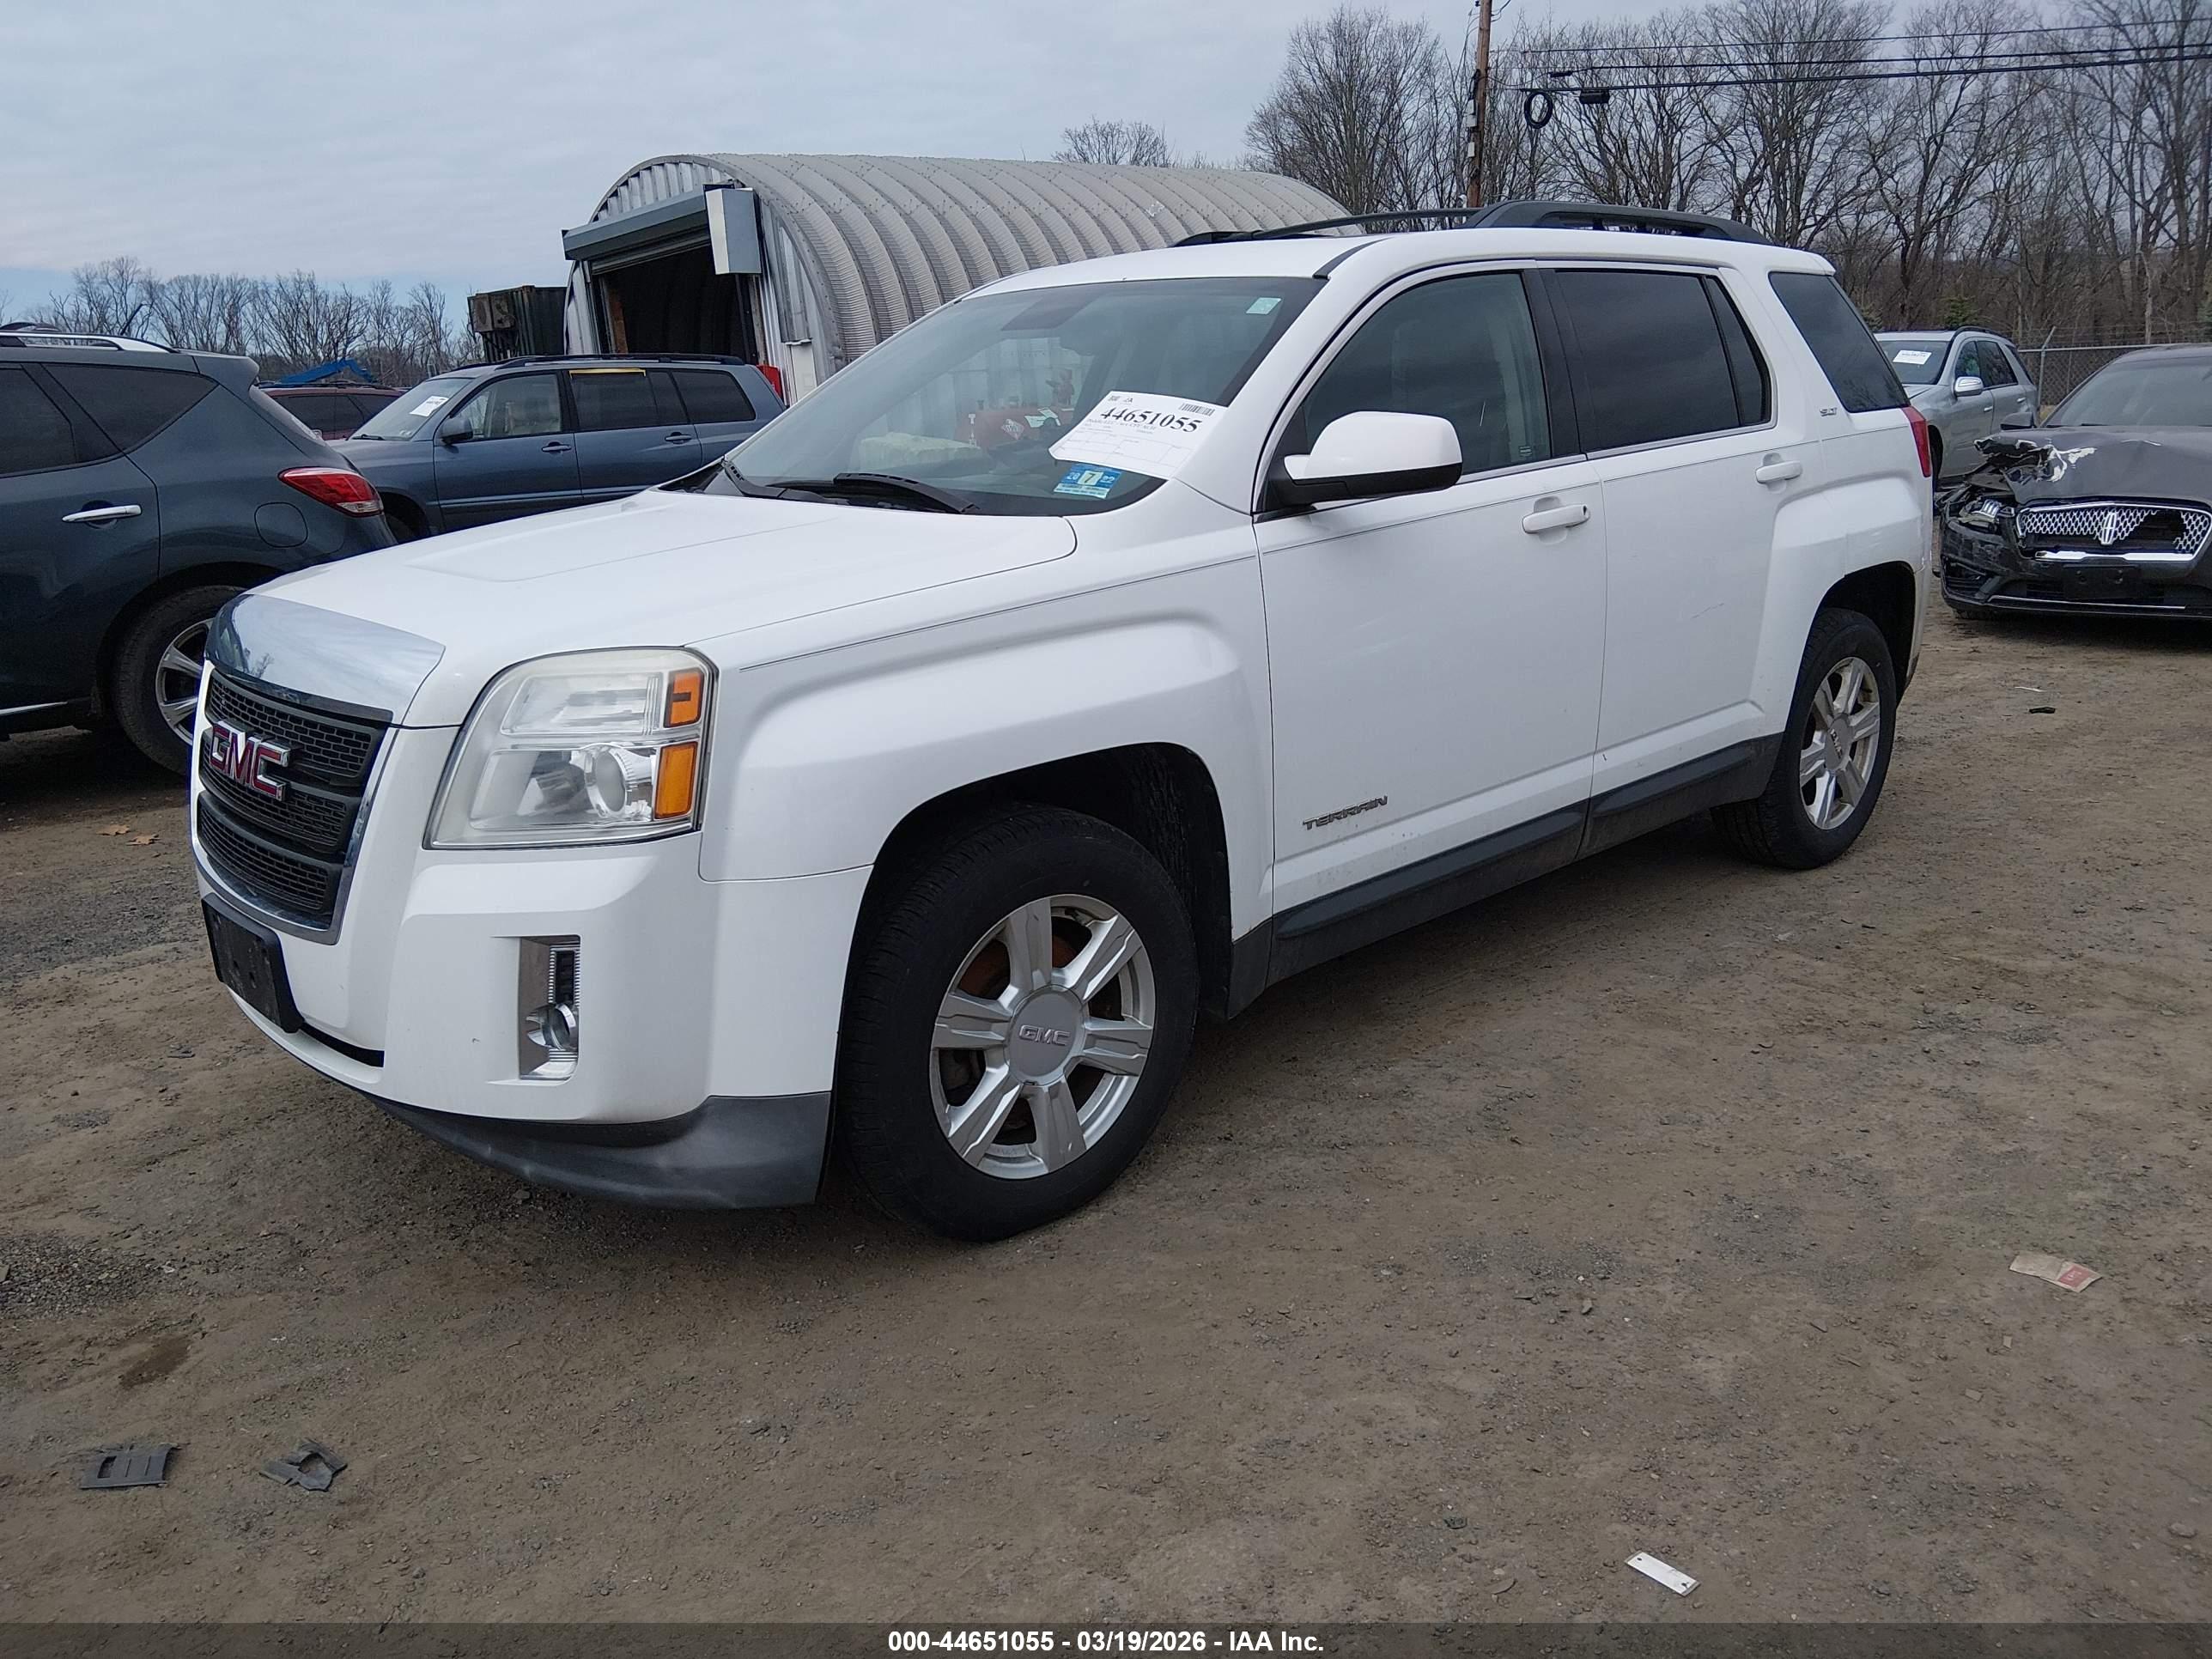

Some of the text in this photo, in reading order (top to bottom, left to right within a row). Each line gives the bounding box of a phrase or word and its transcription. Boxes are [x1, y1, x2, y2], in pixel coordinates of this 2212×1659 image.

[1100, 407, 1202, 433] 44651055
[1084, 472, 1096, 483] 7
[210, 720, 290, 801] GMC
[1302, 794, 1388, 830] TERRAIN
[1018, 1024, 1071, 1046] GMC
